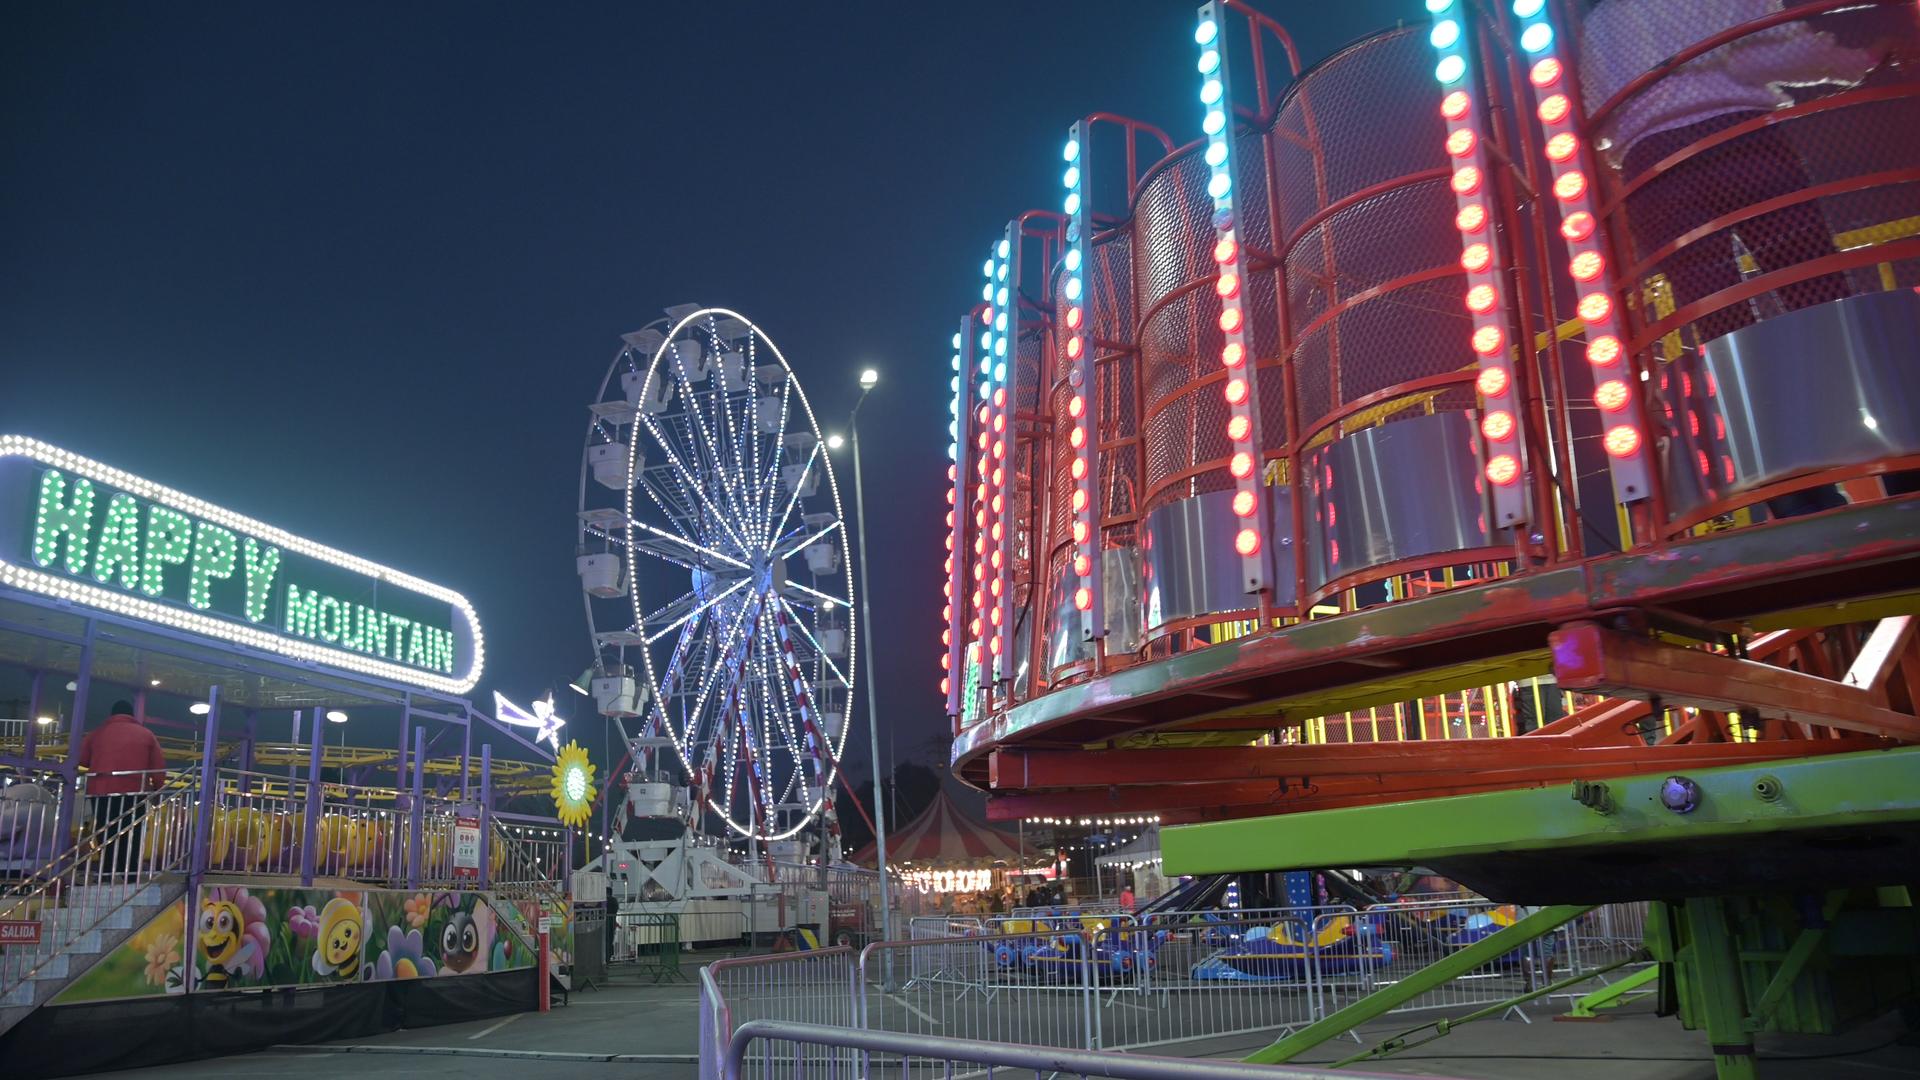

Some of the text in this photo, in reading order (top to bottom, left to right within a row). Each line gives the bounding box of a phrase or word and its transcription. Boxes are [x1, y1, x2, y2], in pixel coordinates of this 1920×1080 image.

[32, 469, 454, 674] HAPPY MOUNTAIN
[1, 925, 35, 938] SALIDA
